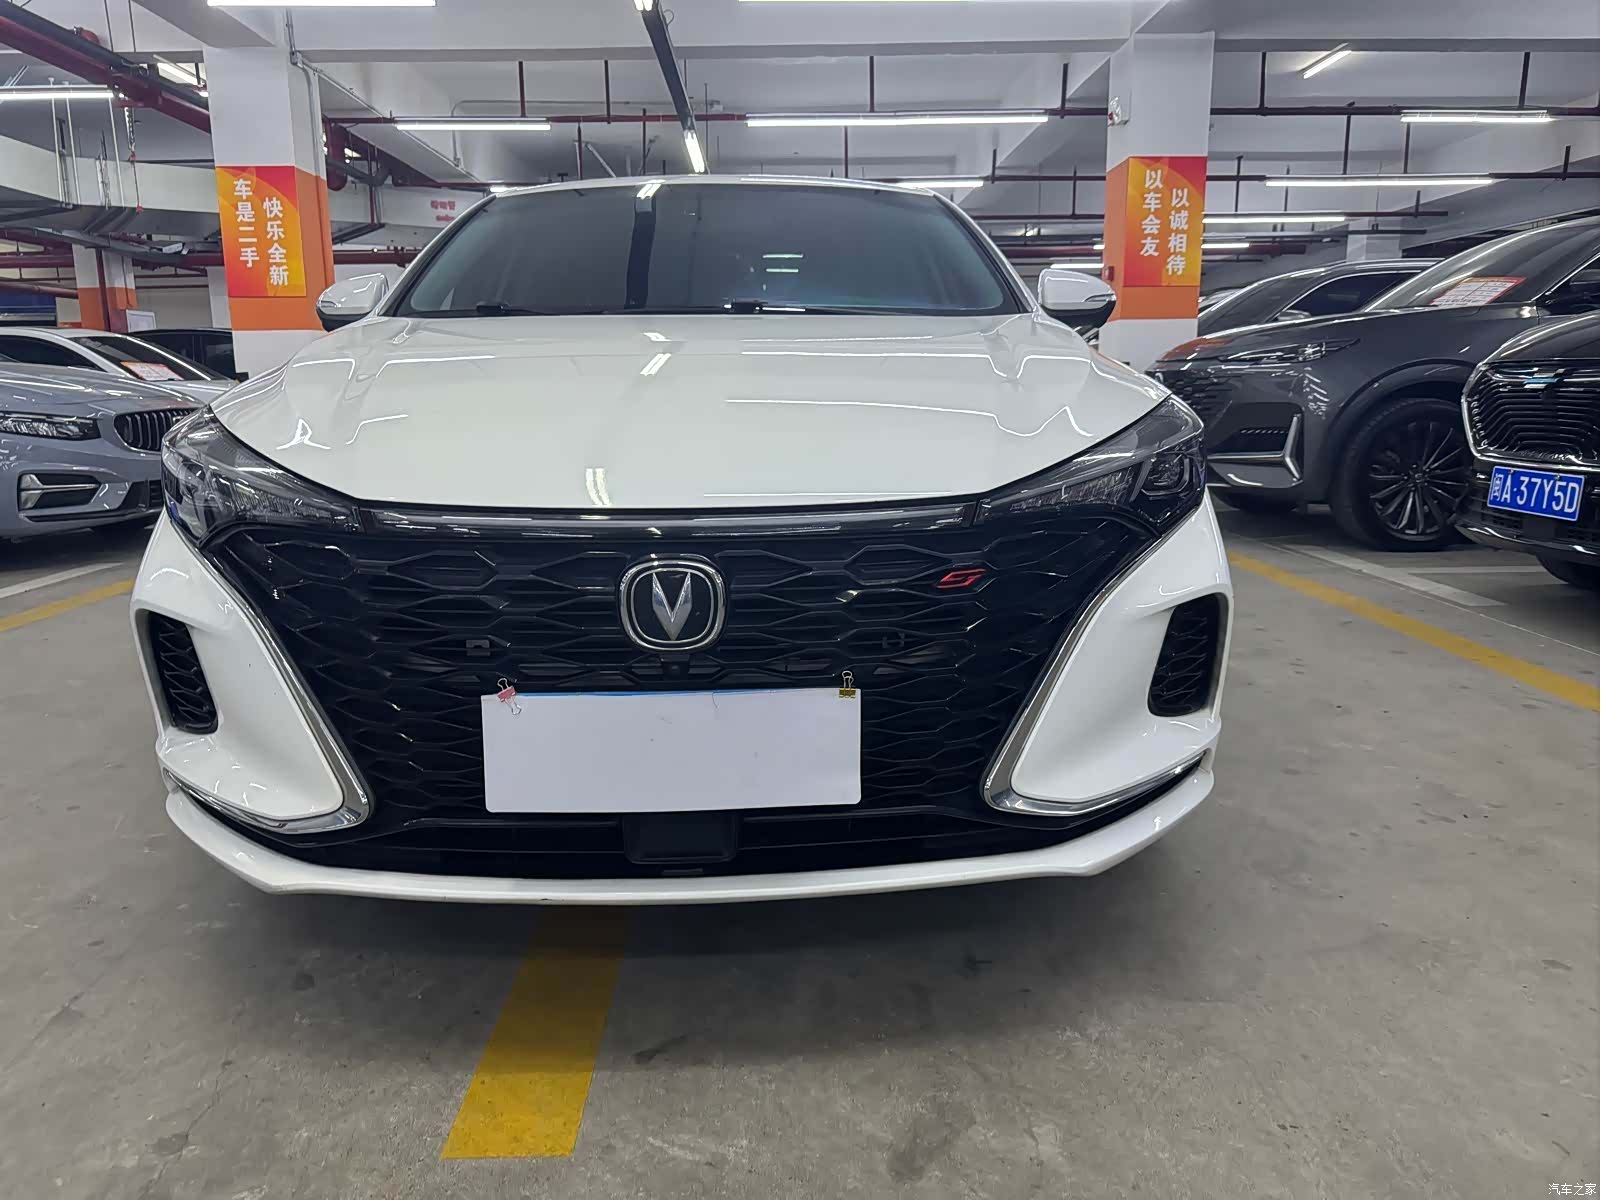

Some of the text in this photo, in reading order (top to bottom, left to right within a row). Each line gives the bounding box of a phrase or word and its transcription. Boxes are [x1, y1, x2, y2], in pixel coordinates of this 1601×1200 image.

[233, 178, 260, 268] 车是二手
[262, 196, 289, 287] 快乐全新
[1140, 169, 1164, 257] 以车会友
[1166, 187, 1190, 276] 以诚相待
